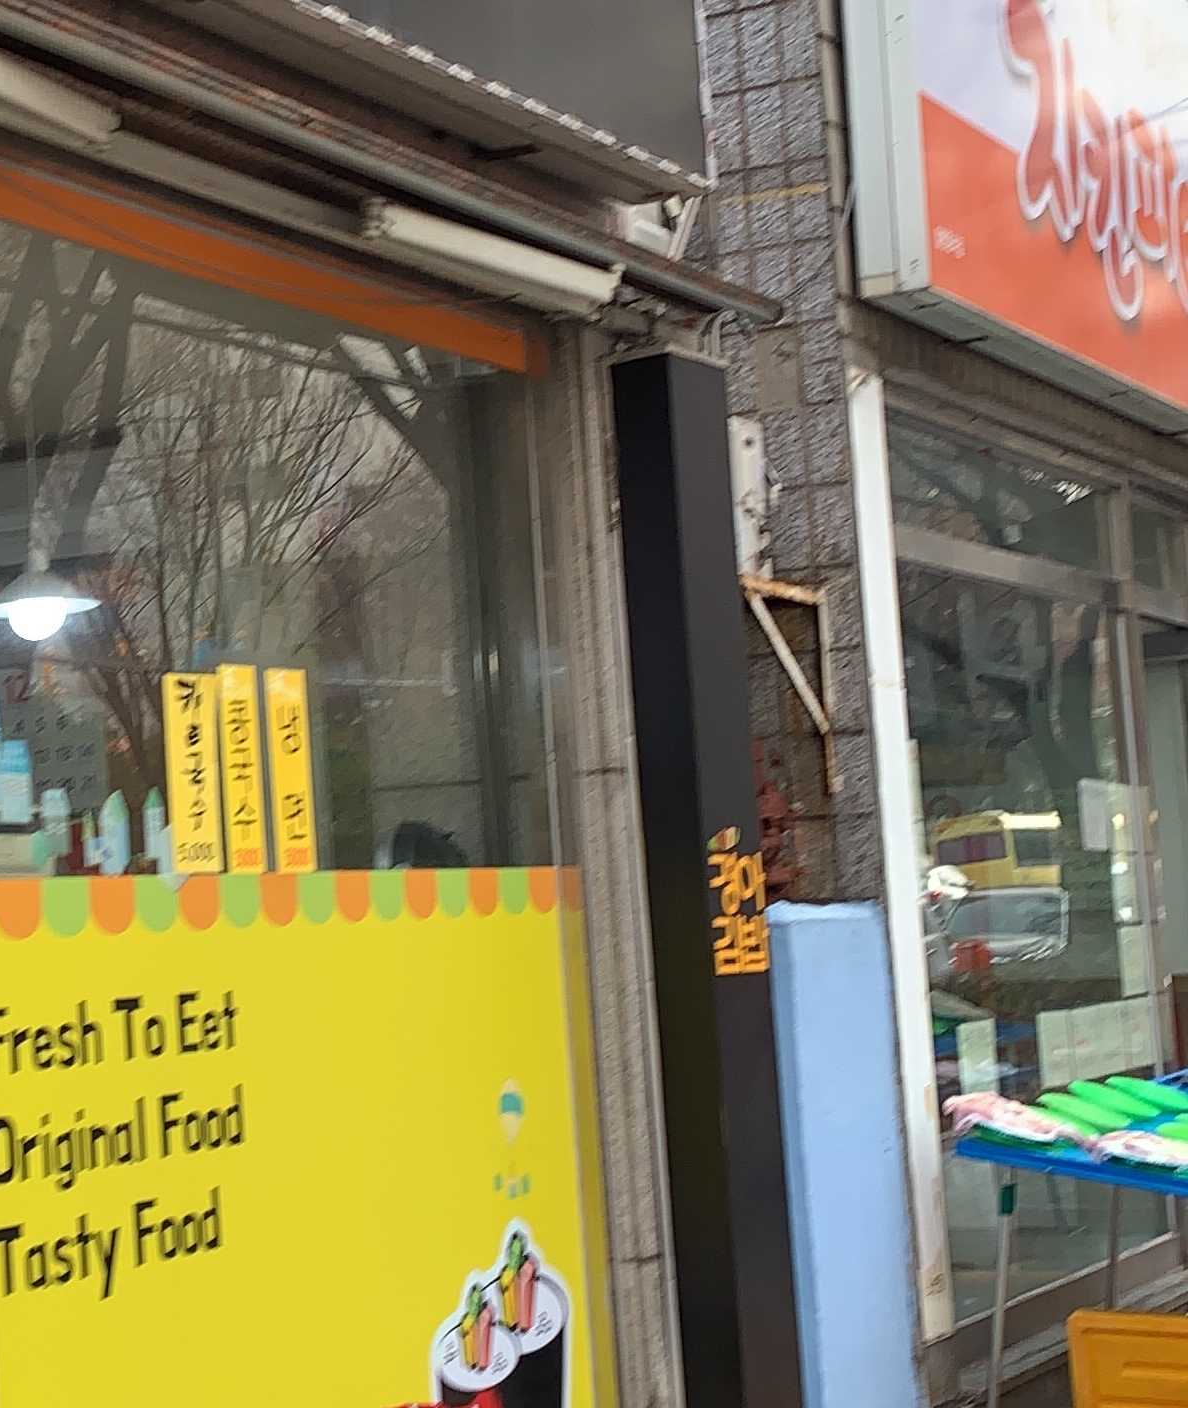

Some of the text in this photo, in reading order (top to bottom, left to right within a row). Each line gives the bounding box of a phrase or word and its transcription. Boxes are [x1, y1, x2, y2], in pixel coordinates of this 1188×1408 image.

[707, 851, 767, 916] 경아
[710, 913, 771, 977] 김밥
[110, 994, 167, 1062] To
[156, 1082, 246, 1160] Food
[132, 1184, 224, 1270] Food
